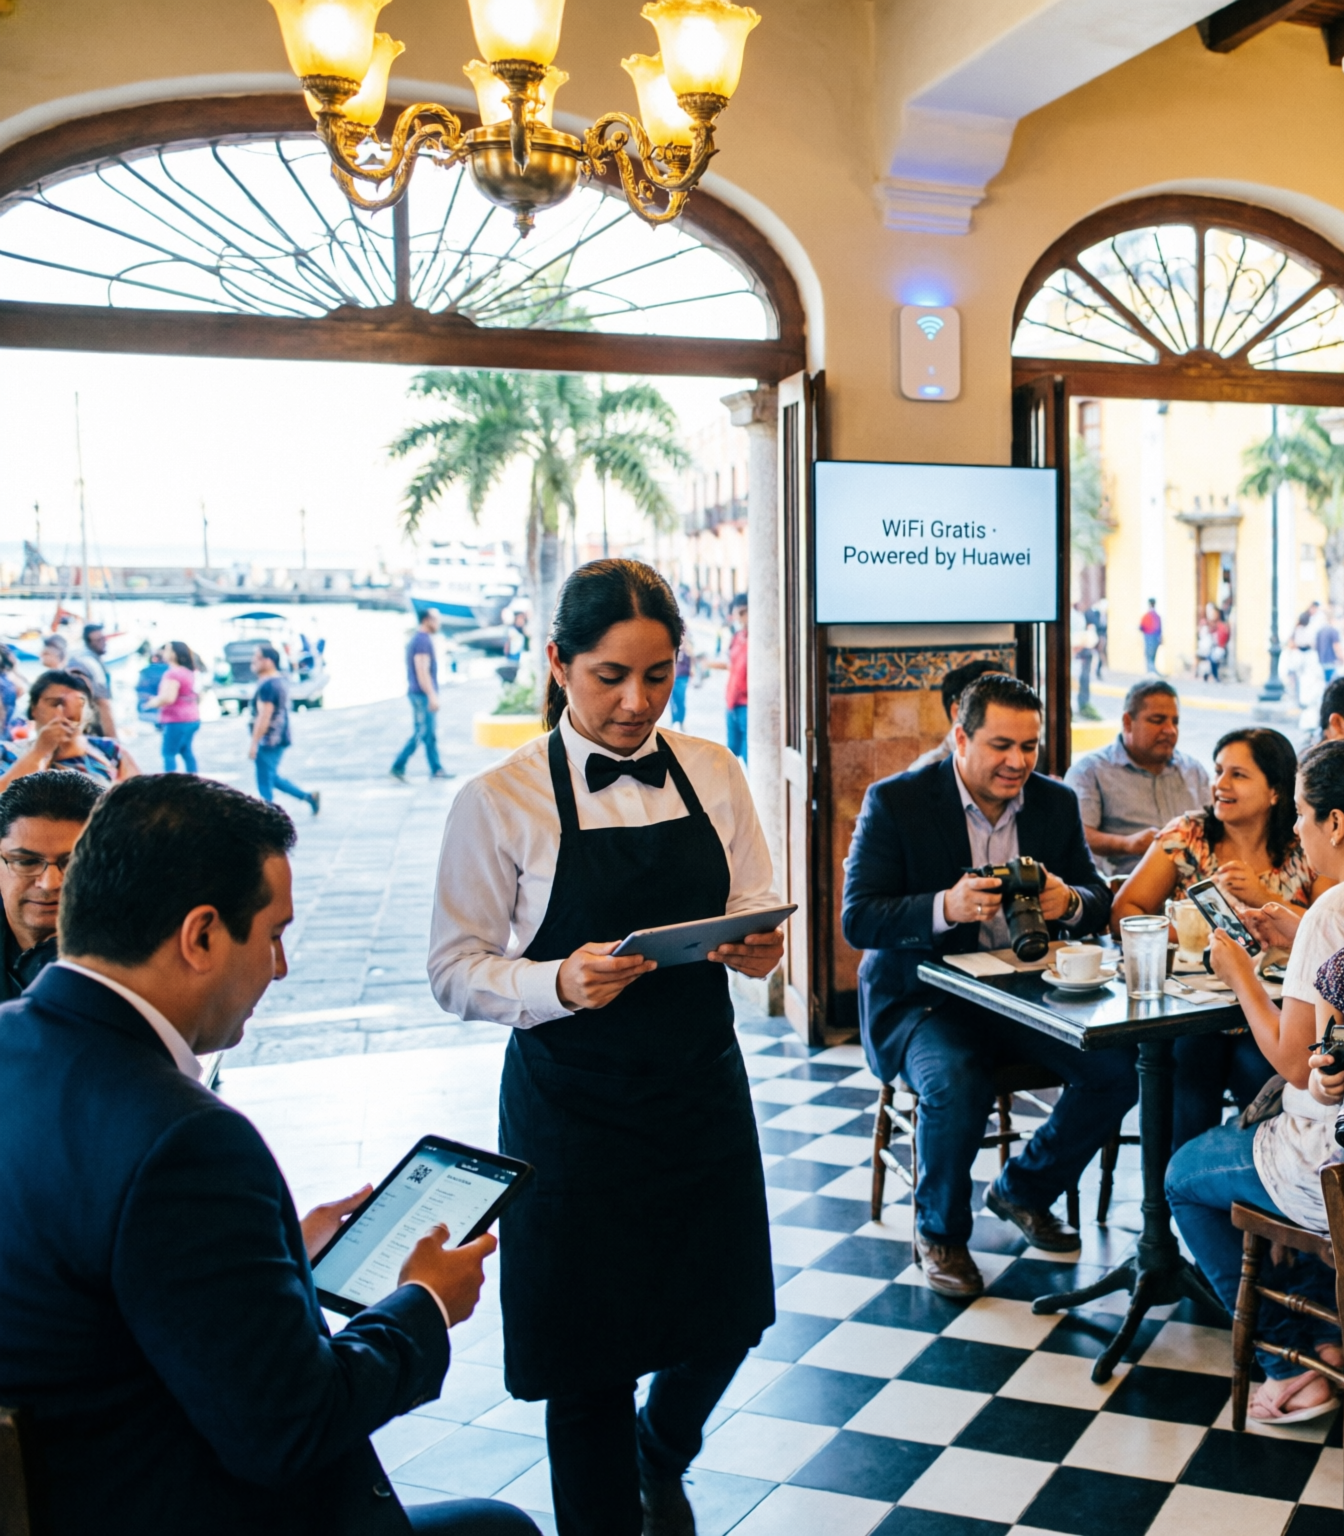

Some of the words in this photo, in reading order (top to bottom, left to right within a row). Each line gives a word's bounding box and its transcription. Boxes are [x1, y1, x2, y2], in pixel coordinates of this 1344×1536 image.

[881, 519, 924, 538] WiFi
[930, 520, 986, 539] Gratis
[843, 545, 928, 565] Powered
[935, 546, 957, 570] by
[962, 547, 1031, 566] Huawei
